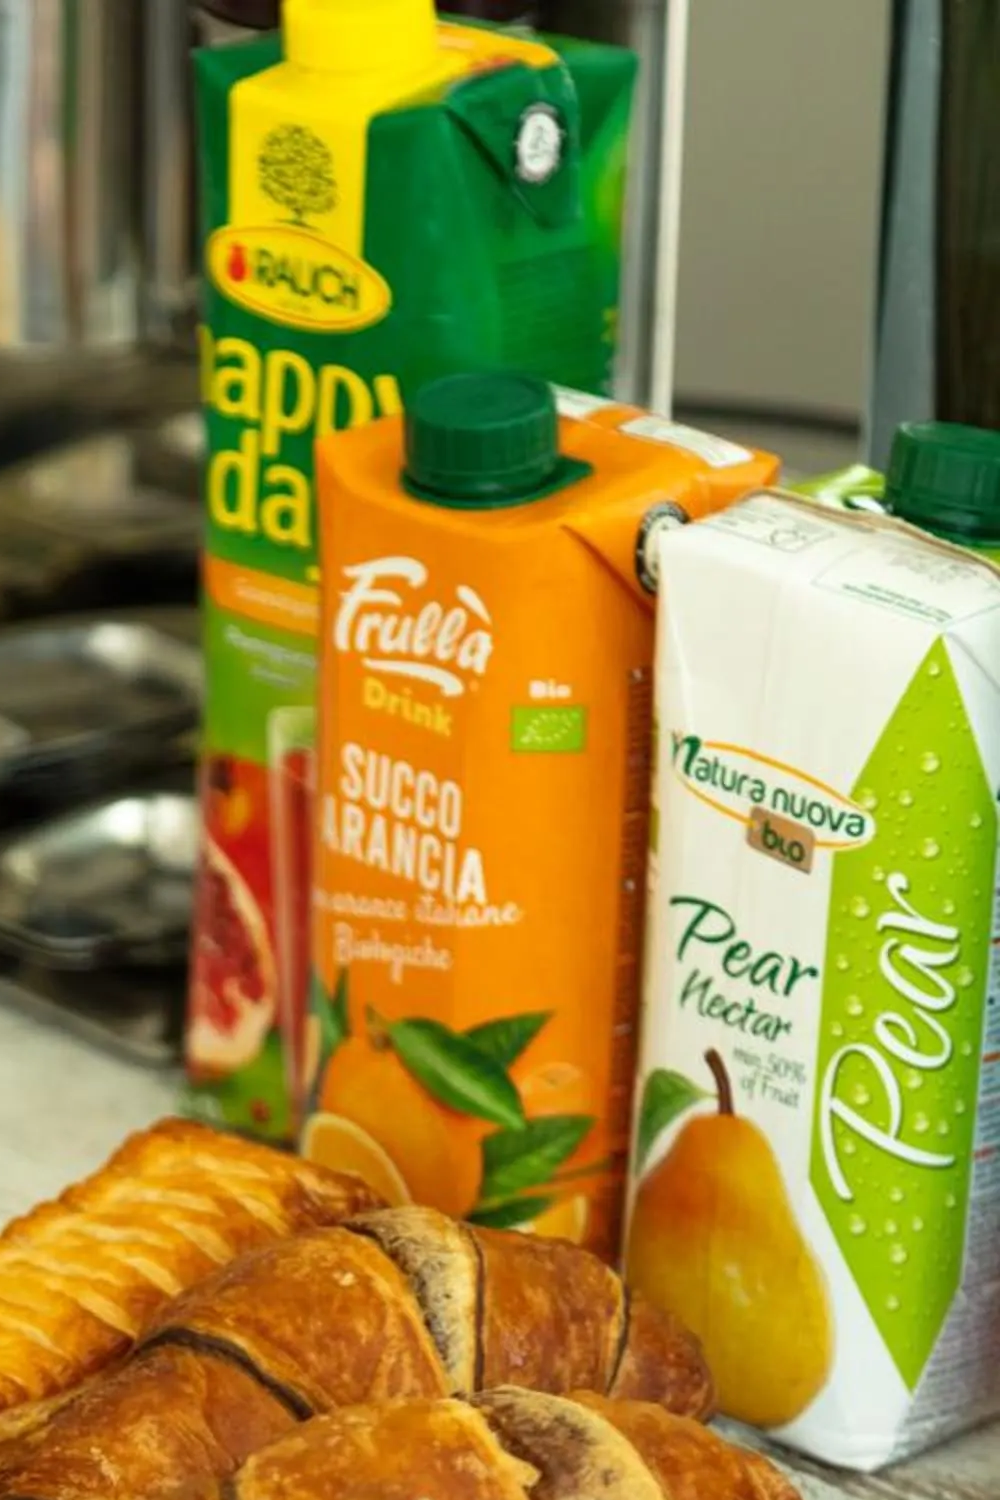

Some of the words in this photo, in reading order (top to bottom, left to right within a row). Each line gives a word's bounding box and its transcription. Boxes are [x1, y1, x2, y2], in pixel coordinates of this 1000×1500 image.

[256, 247, 360, 312] RAUCH
[197, 323, 404, 457] app
[207, 427, 313, 548] da
[333, 555, 495, 675] Frullà
[362, 675, 453, 738] Drink
[528, 679, 573, 700] Bio
[340, 742, 463, 840] SUCCO
[671, 730, 766, 804] natura
[771, 787, 867, 838] nuova
[320, 794, 488, 904] ARANCIA
[760, 819, 807, 863] bio
[669, 895, 819, 998] Pear
[679, 967, 794, 1044] Nectar
[820, 871, 960, 1202] Pear
